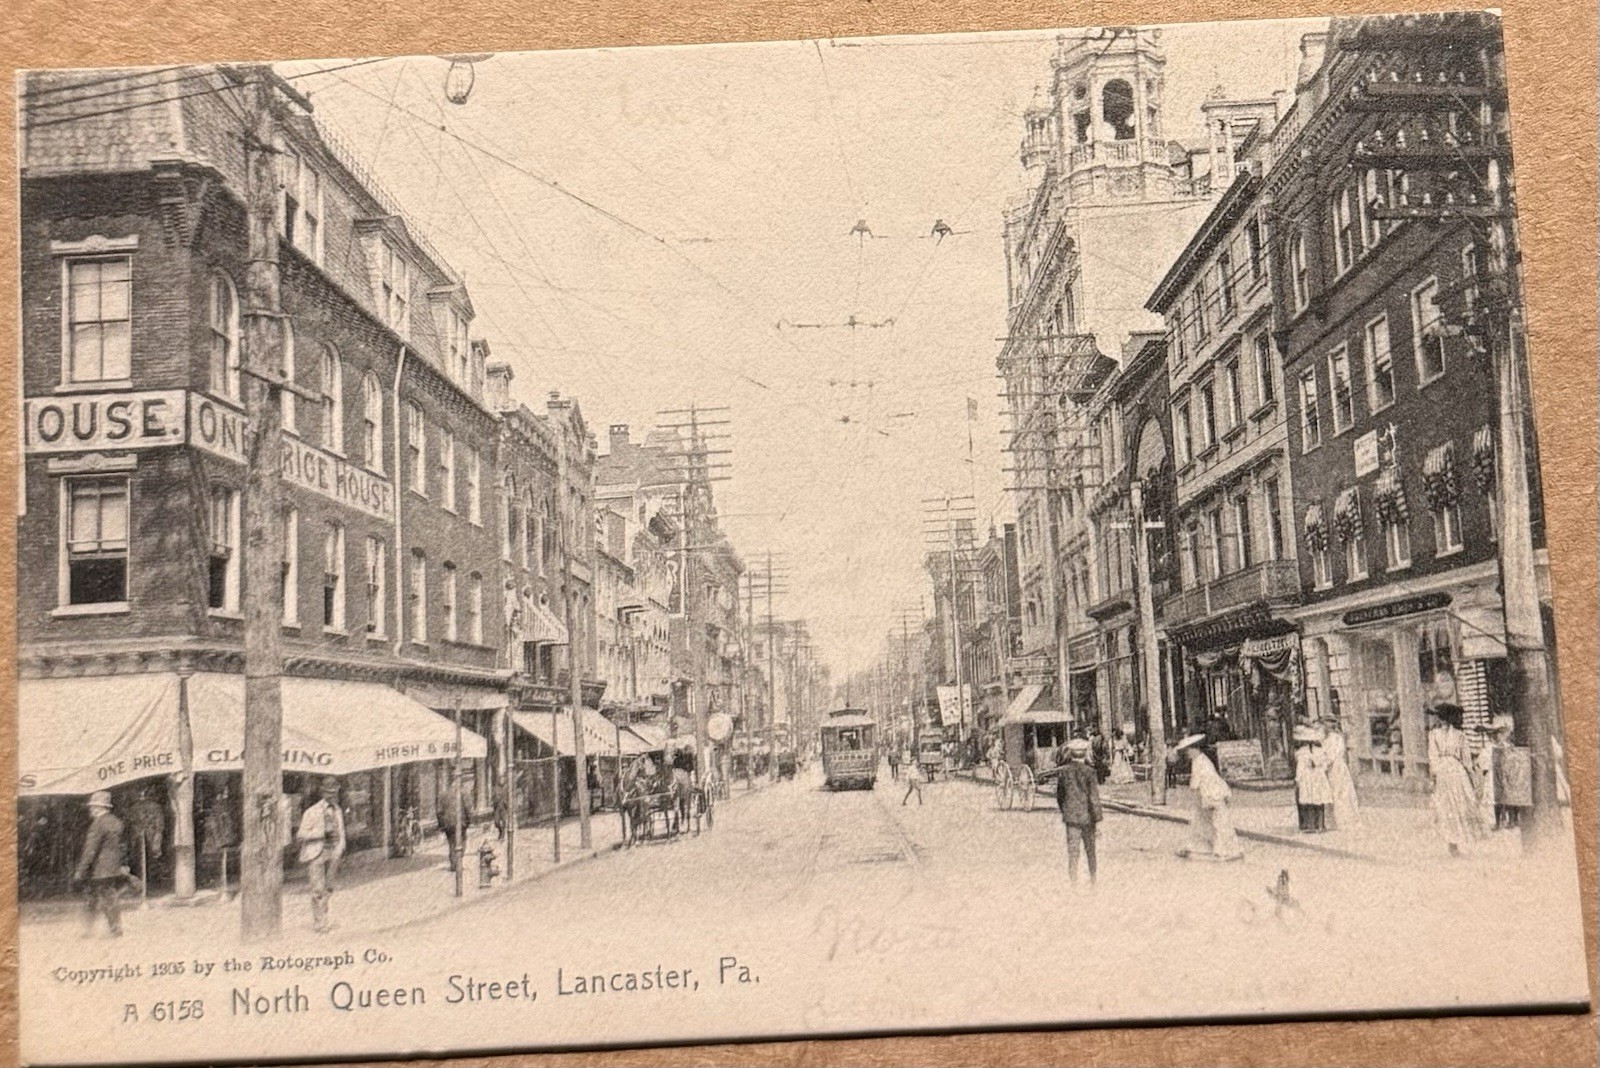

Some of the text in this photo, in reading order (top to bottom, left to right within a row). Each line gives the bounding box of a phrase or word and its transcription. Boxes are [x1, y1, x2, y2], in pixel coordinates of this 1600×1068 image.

[25, 399, 181, 442] OUSE.
[281, 441, 329, 489] RICE
[336, 461, 390, 514] HOUSE
[99, 752, 174, 781] ONE PRICE
[207, 750, 332, 766] CLHING
[375, 745, 420, 760] HIRSH
[52, 962, 143, 985] Copyright
[194, 958, 215, 977] by
[224, 957, 252, 972] the
[261, 950, 354, 972] Rotograph
[363, 948, 393, 964] Co.
[123, 956, 761, 1023] A 6158 North Queen Street, Lancaster, Pa.
